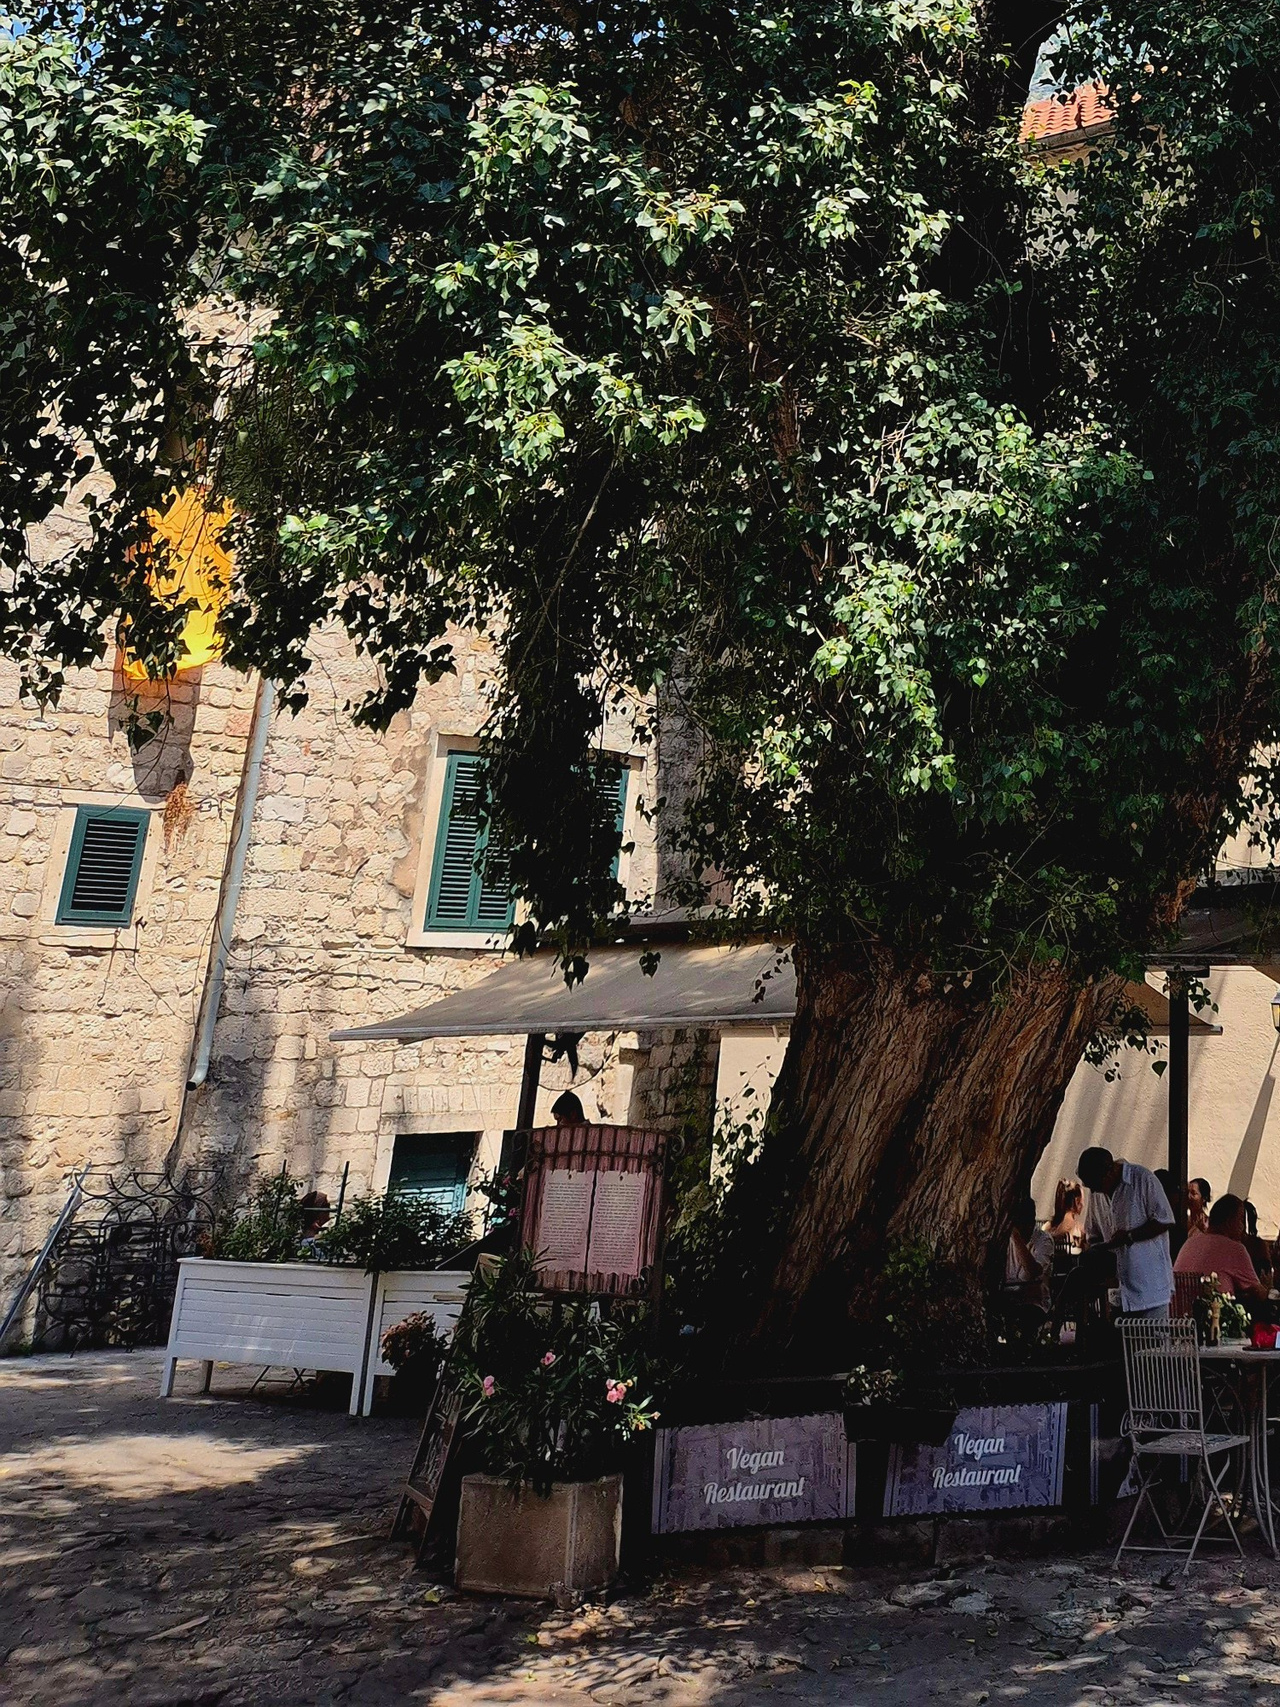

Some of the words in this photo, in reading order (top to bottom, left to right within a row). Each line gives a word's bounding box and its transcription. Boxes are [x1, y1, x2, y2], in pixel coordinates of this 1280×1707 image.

[954, 1433, 1004, 1460] Vegan
[727, 1447, 784, 1474] Vegan
[932, 1464, 1021, 1489] Restaurant
[704, 1477, 804, 1505] Restaurant
